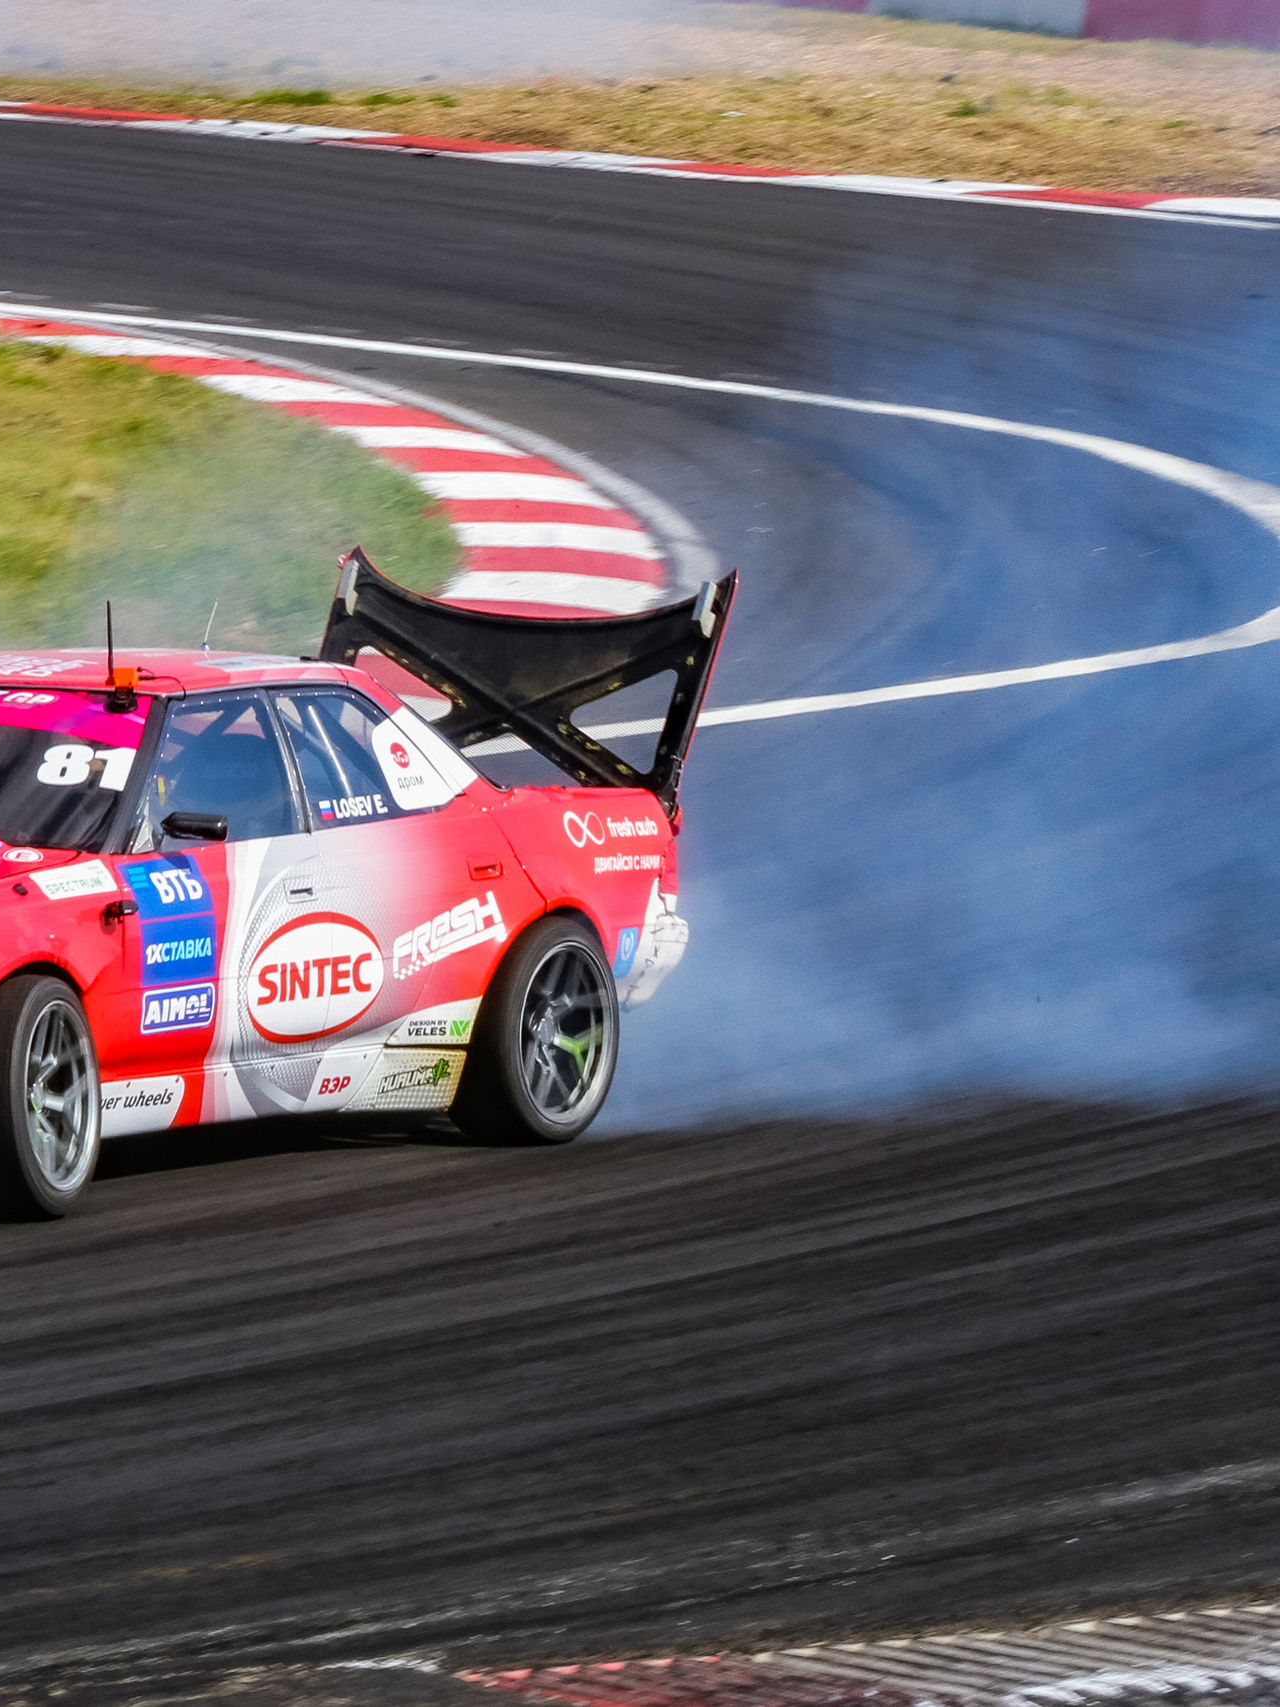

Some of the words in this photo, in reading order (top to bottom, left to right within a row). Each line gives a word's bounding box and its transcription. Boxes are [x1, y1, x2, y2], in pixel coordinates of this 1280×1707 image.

[3, 691, 55, 705] GP
[37, 744, 137, 792] 81
[333, 796, 373, 820] LOSEV
[606, 816, 636, 837] fresh
[634, 816, 658, 836] auto
[45, 877, 103, 894] SPECTRUM
[149, 868, 203, 904] ВТБ
[257, 952, 372, 1006] SINTEC
[144, 993, 211, 1025] AIMOL
[408, 1027, 447, 1036] VELES
[123, 1088, 174, 1108] wheels
